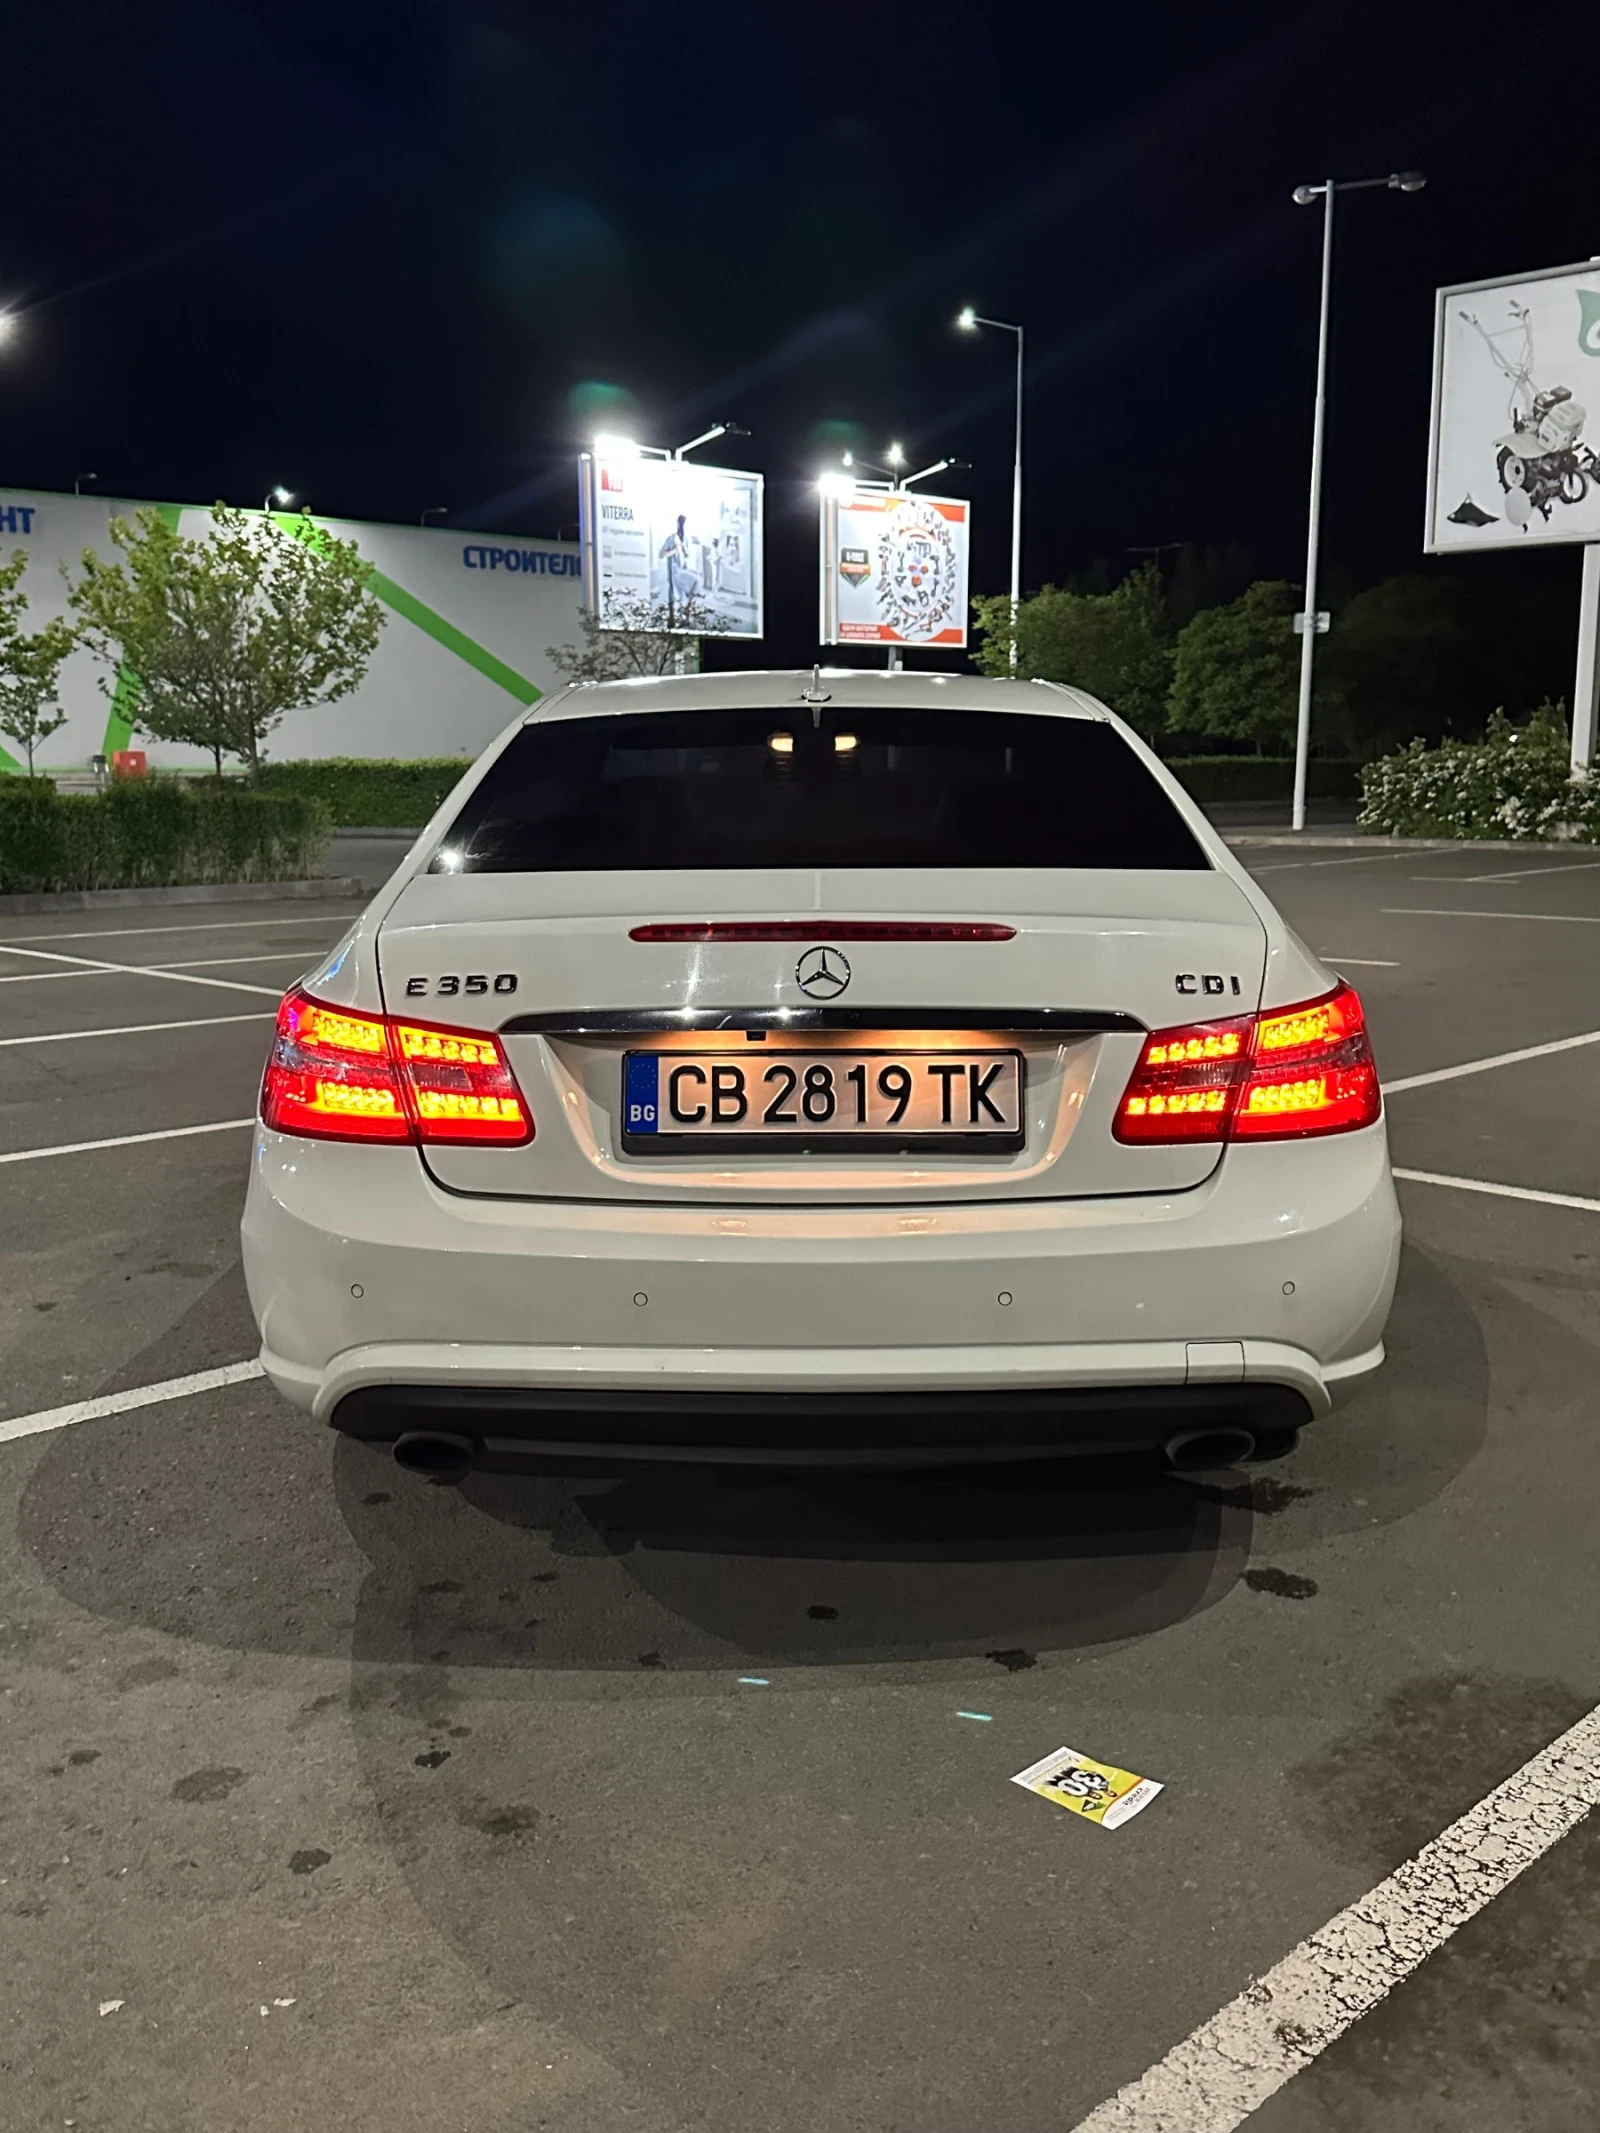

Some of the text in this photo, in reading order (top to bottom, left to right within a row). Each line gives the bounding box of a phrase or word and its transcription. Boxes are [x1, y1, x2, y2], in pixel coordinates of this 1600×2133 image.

[601, 504, 635, 521] VITERRA
[406, 973, 518, 997] E 350
[1175, 973, 1241, 996] CDI
[669, 1063, 1006, 1124] CB 2819 TK
[630, 1104, 656, 1122] BG
[1121, 1786, 1143, 1807] credit
